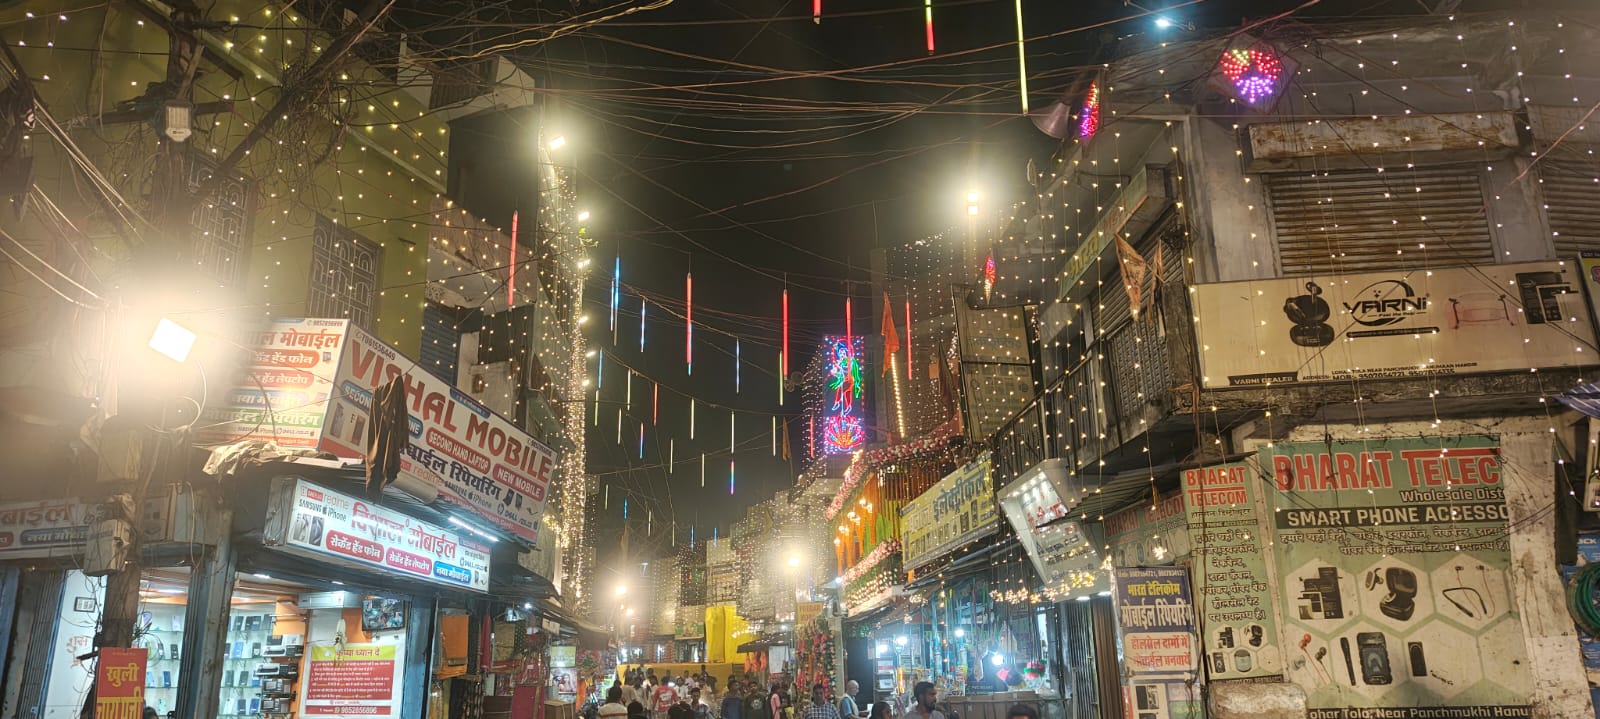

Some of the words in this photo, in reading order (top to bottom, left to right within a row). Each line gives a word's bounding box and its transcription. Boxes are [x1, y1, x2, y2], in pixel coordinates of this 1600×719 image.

[1343, 297, 1427, 315] VARNI
[428, 431, 452, 453] SECOND
[453, 443, 469, 460] HAND
[469, 450, 489, 471] LAPTOP
[465, 413, 552, 483] MOBILE
[497, 466, 514, 484] NEW
[515, 476, 542, 498] MOBILE
[1186, 466, 1245, 486] BHARAT
[1273, 450, 1393, 493] BHARAT
[1401, 448, 1501, 488] TELEC
[1188, 487, 1248, 507] TELECOM
[1401, 488, 1473, 502] Wholesale
[1105, 507, 1139, 538] BHARAT
[1287, 511, 1353, 526] SMART
[1357, 508, 1419, 525] PHONE
[1424, 504, 1508, 522] ACCESSO
[1120, 598, 1155, 630] मोबाईल
[105, 663, 140, 687] खुली
[1376, 708, 1406, 719] Near
[1410, 706, 1491, 719] Panchmukhi
